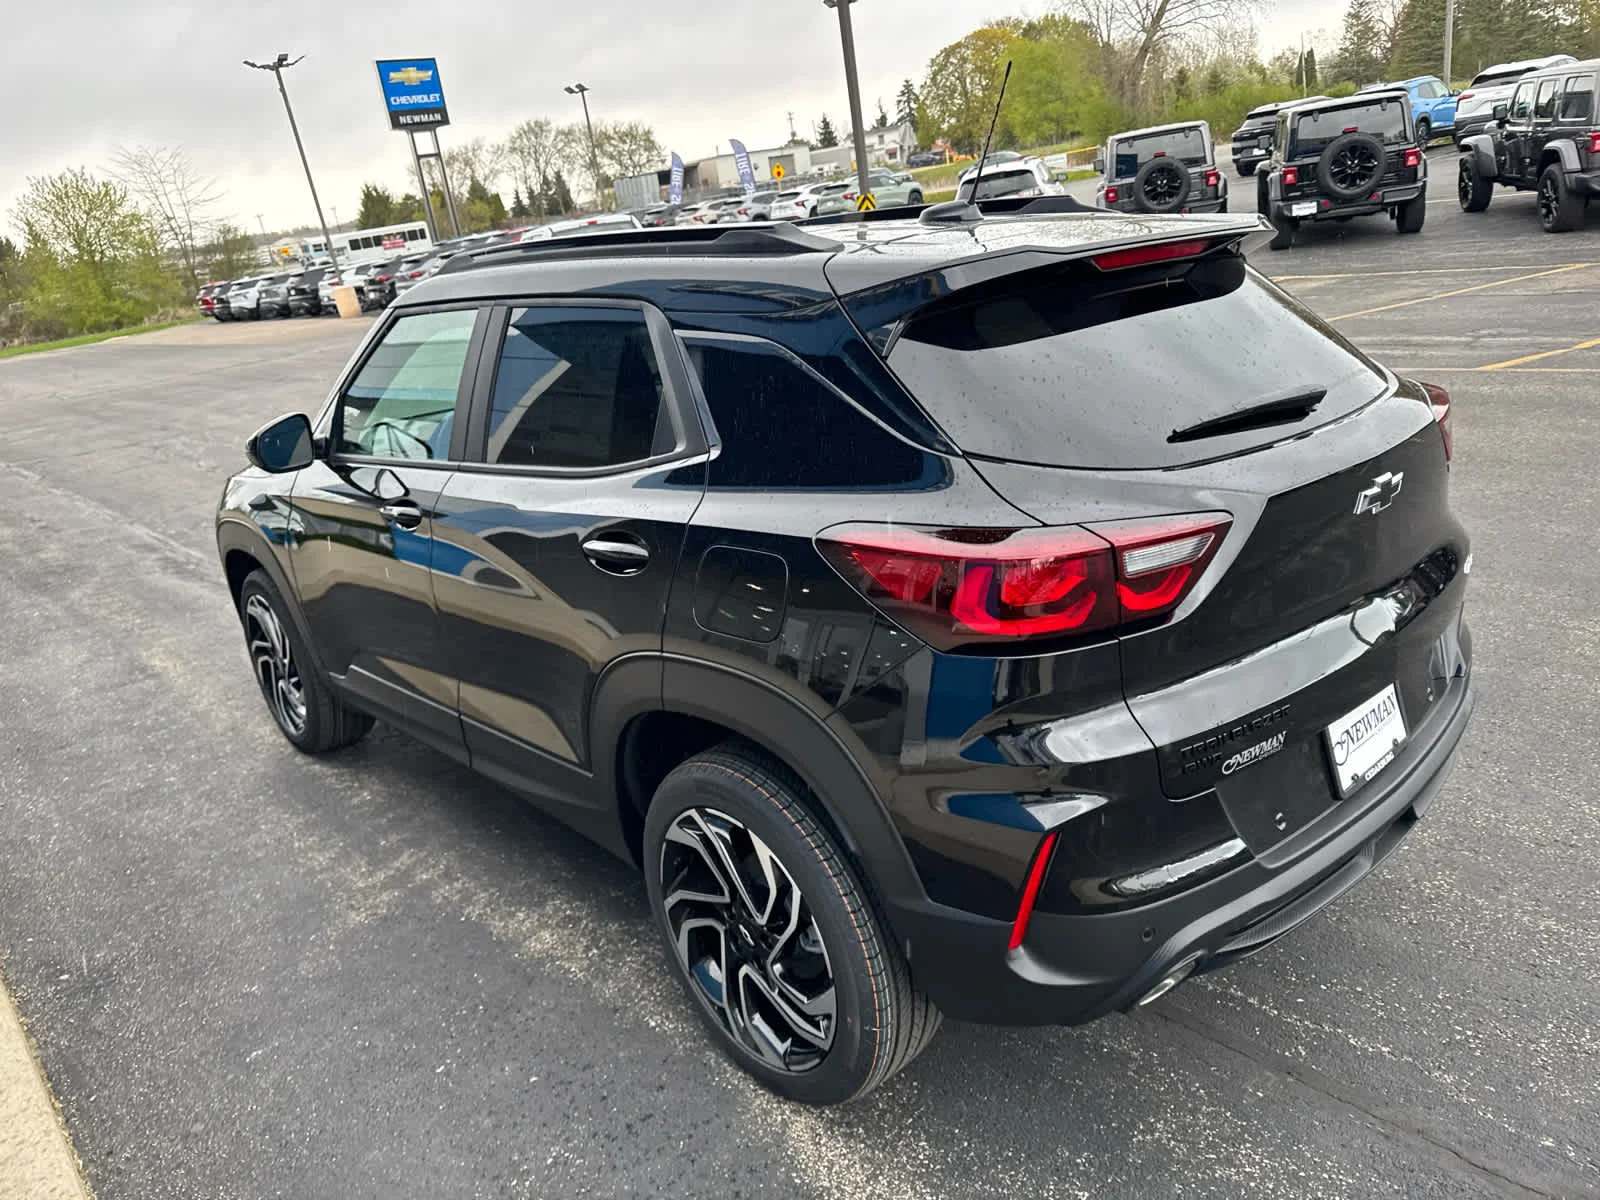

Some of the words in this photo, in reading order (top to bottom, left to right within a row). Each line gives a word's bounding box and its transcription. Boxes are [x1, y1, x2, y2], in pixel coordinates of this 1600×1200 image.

[391, 93, 440, 105] CHEVROLET
[399, 113, 441, 124] NEWMAN
[1333, 691, 1397, 767] NEWMAN
[1221, 730, 1287, 775] NEWMAN
